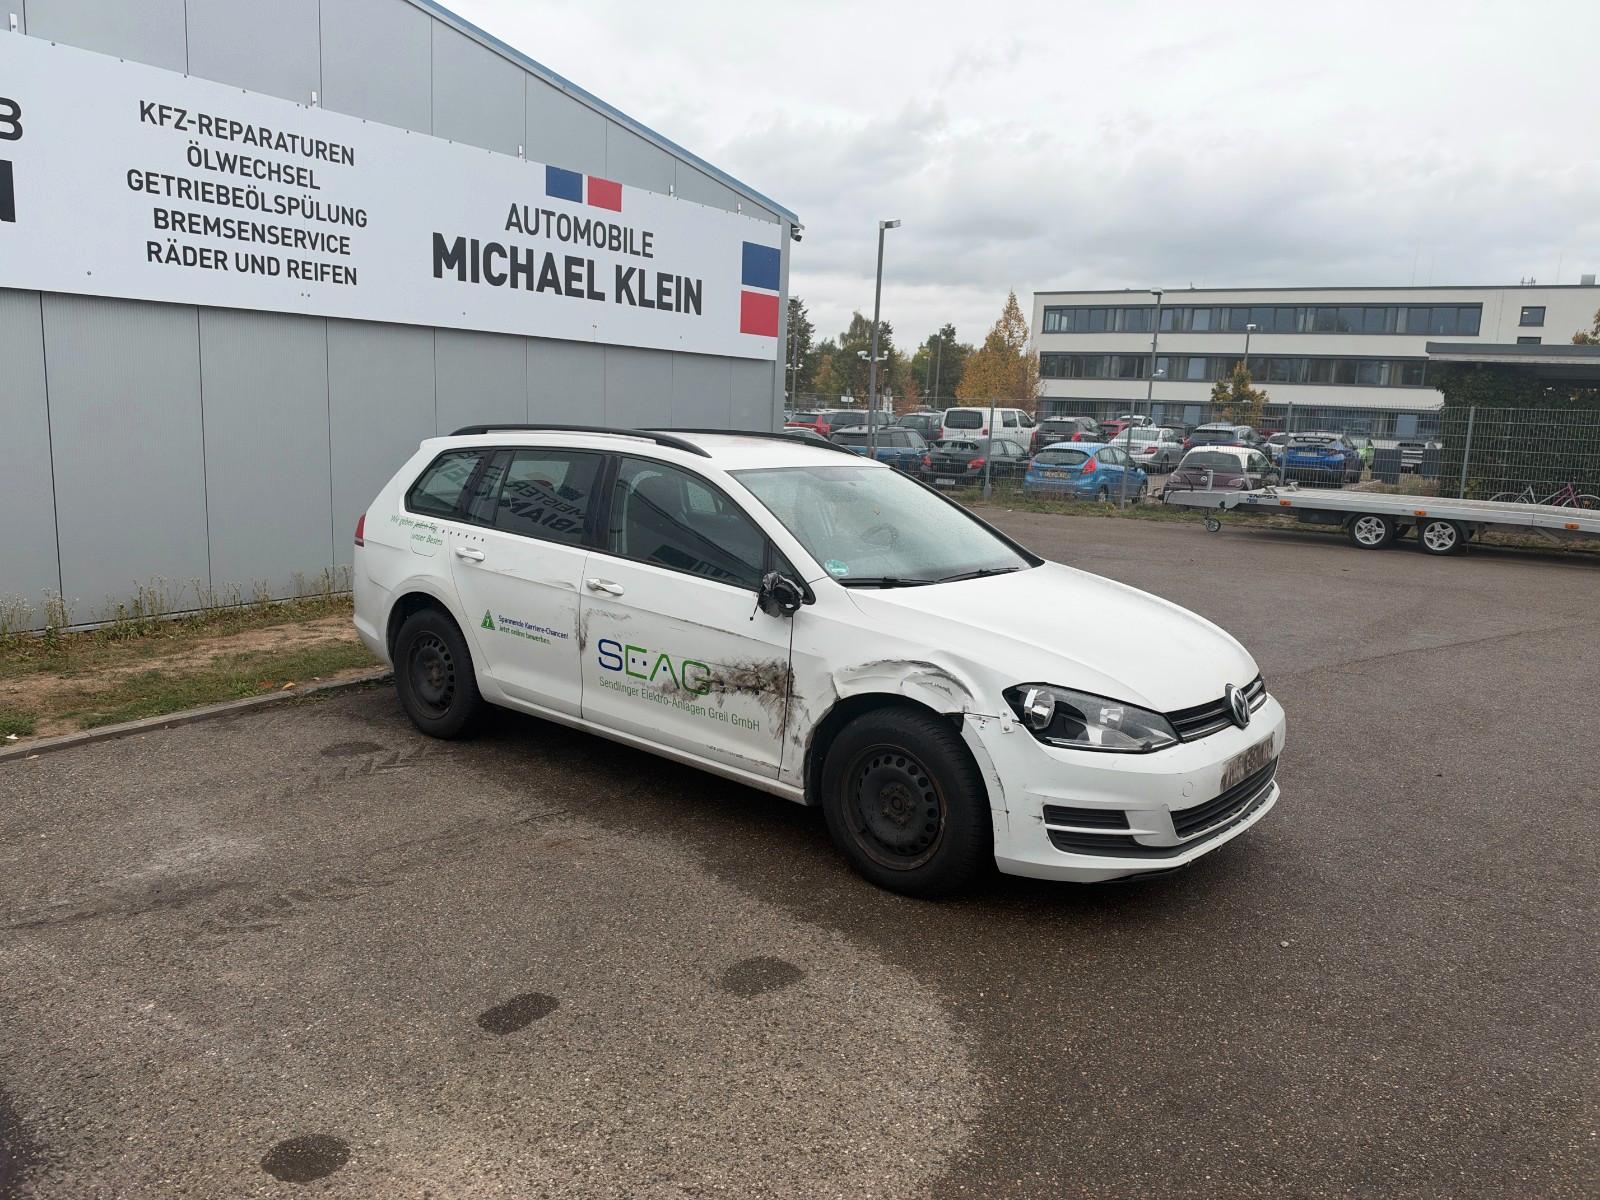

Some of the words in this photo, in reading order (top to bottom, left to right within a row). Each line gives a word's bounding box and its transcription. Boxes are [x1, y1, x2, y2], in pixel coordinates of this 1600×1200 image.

[139, 99, 355, 167] KFZ-REPARATUREN
[186, 140, 321, 190] ÖLWECHSEL
[126, 169, 368, 228] GETRIEBEÖLSPÜLUNG
[153, 207, 351, 255] BREMSENSERVICE
[505, 202, 654, 259] AUTOMOBILE
[146, 238, 229, 271] RÄDER
[235, 252, 281, 276] UND
[286, 260, 358, 286] REIFEN
[432, 231, 606, 302] MICHAEL
[615, 263, 703, 316] KLEIN
[599, 676, 639, 698] Sendlinger
[641, 686, 706, 717] Elektro-Anlagen
[708, 708, 729, 723] Greil
[731, 713, 761, 731] GmbH
